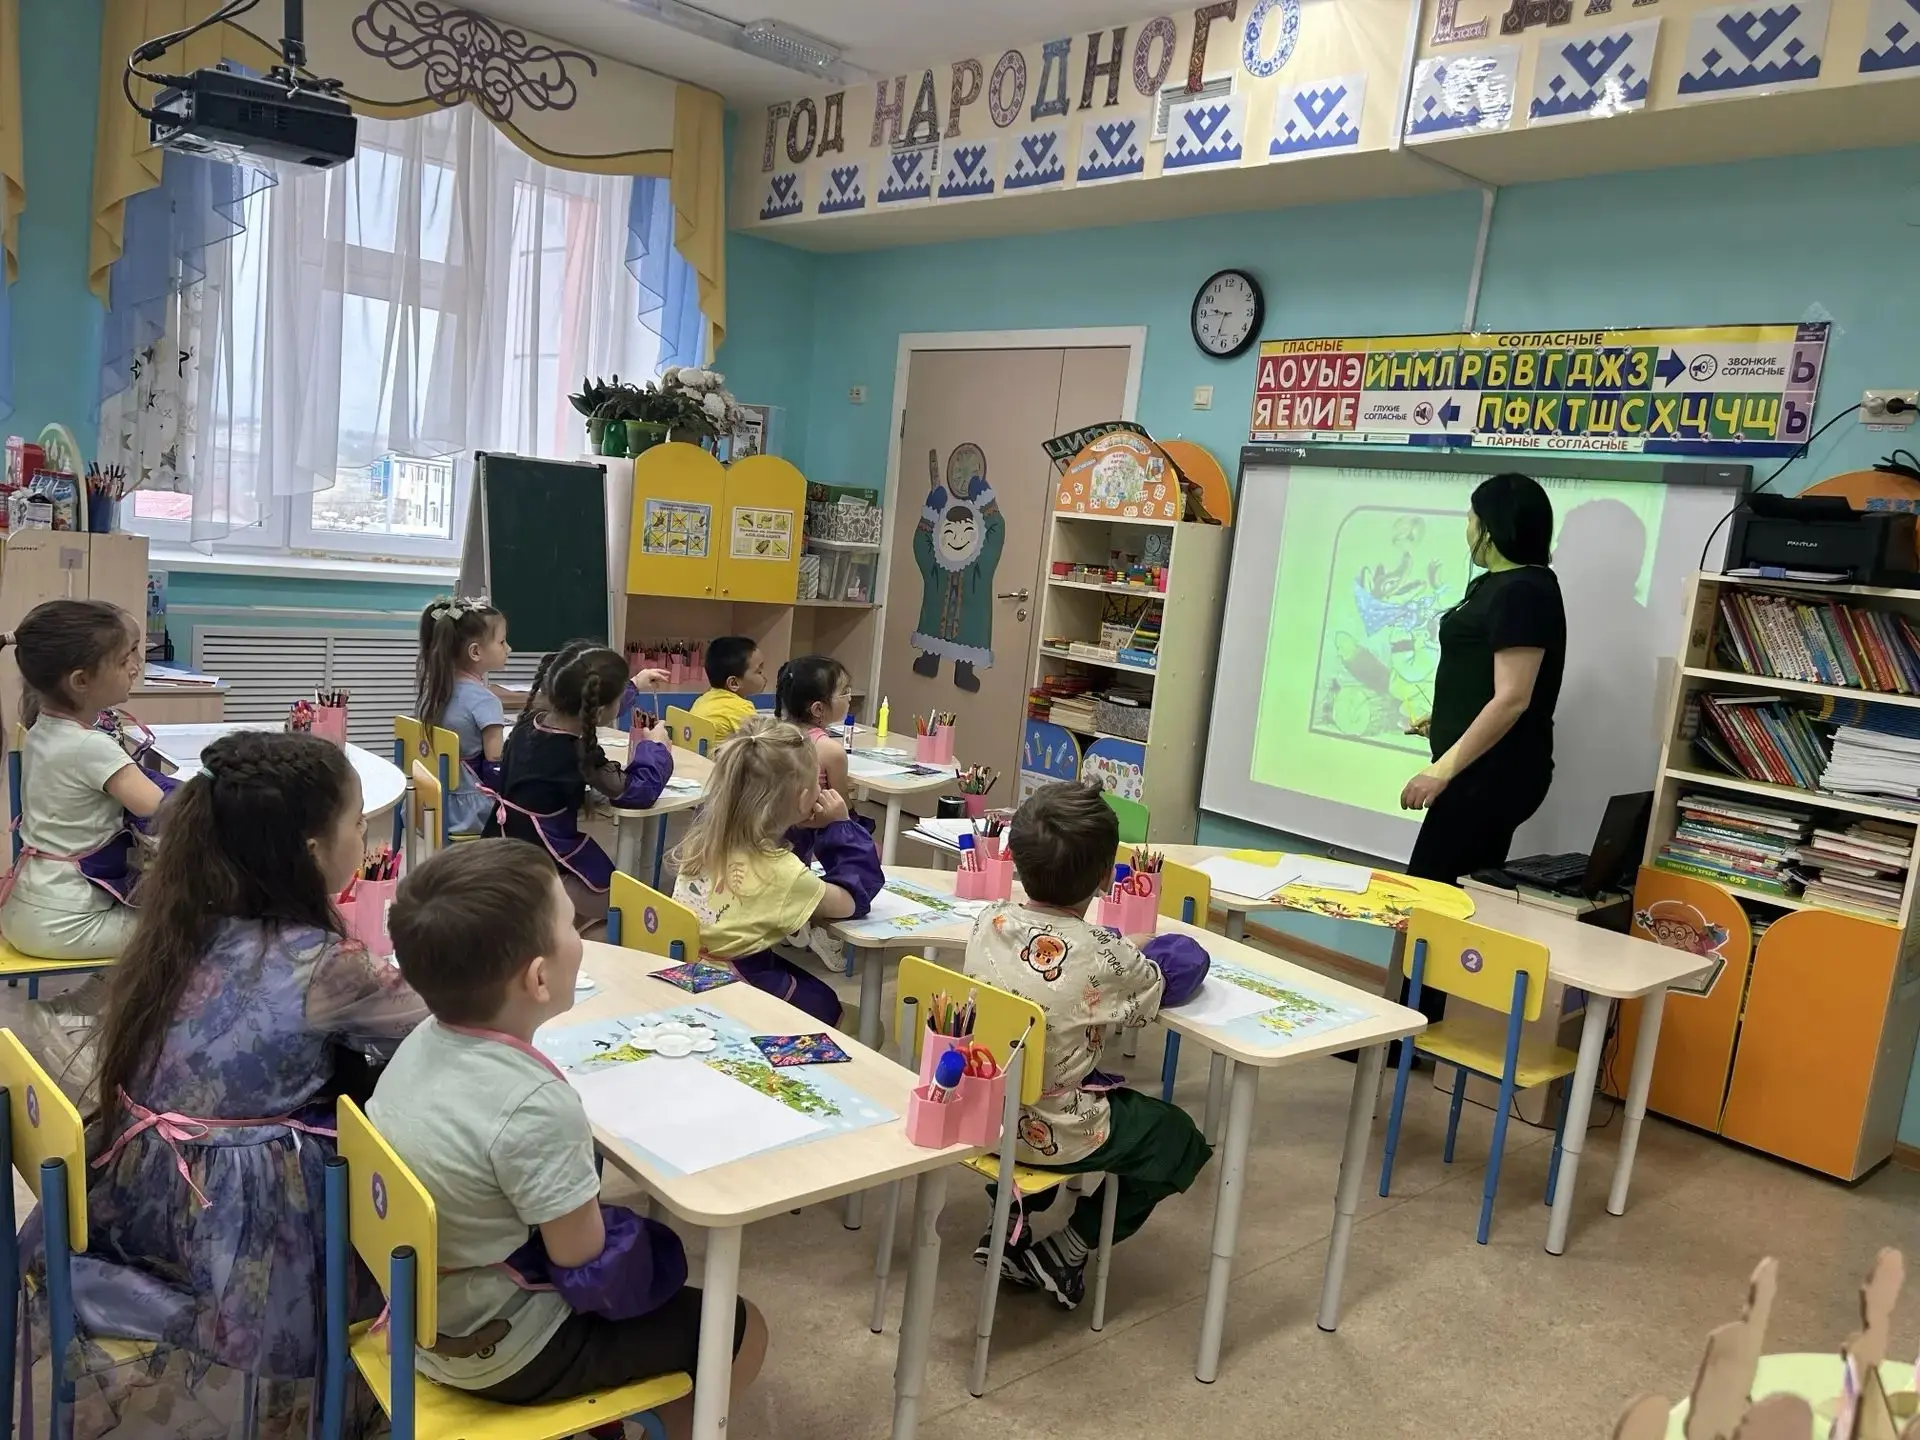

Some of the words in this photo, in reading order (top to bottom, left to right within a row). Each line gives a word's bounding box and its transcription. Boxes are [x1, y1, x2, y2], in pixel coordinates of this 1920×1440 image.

[762, 92, 845, 173] ГОД
[870, 0, 1301, 148] НАРОДНОГО
[1282, 340, 1344, 353] ГЛАСНЫЕ
[1498, 333, 1604, 347] СОГЛАСНЫЕ
[1727, 357, 1777, 367] ЗВОНКИЕ
[1721, 366, 1785, 377] СОГЛАСНЫЕ
[1364, 412, 1408, 421] СОГЛАСНЫЕ
[1486, 436, 1541, 448] ПАРНЫЕ
[1547, 437, 1629, 451] СОГЛАСНЫЕ
[1465, 953, 1479, 969] 2
